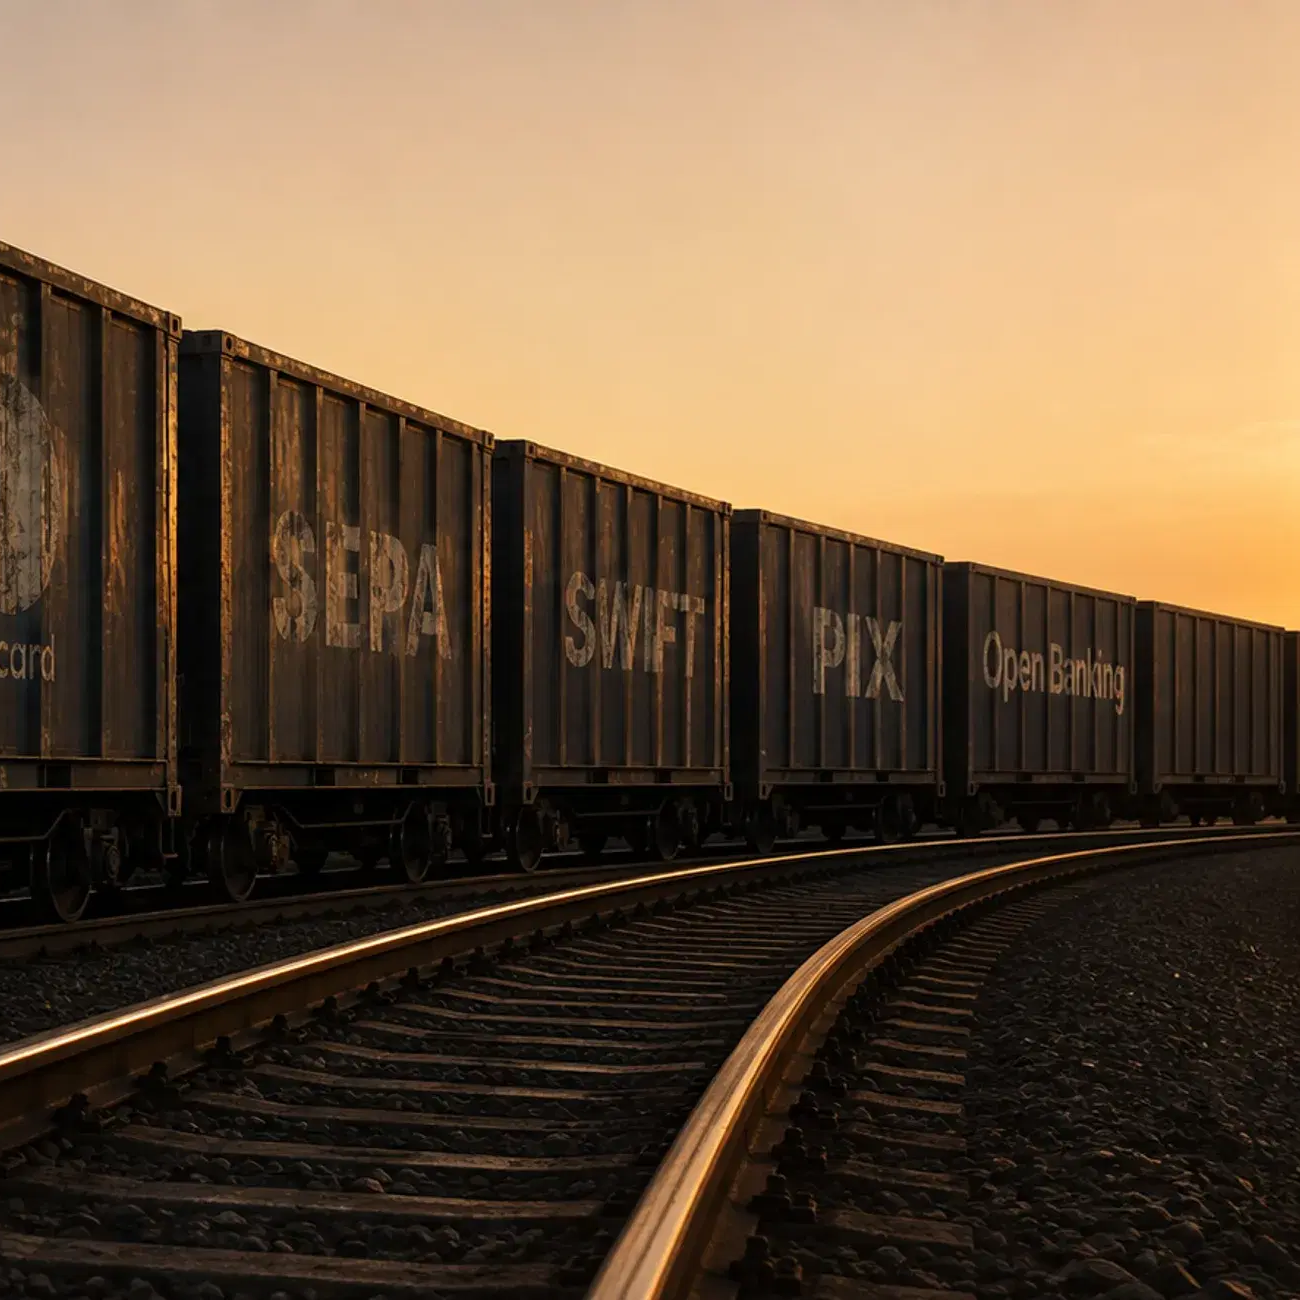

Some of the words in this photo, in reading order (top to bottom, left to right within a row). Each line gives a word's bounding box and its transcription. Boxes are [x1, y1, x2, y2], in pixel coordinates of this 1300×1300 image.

[271, 509, 452, 660] SEPA
[565, 571, 705, 678] SWIFT
[813, 606, 904, 702] PIX
[983, 630, 1045, 703] Open
[1050, 642, 1125, 716] Banking
